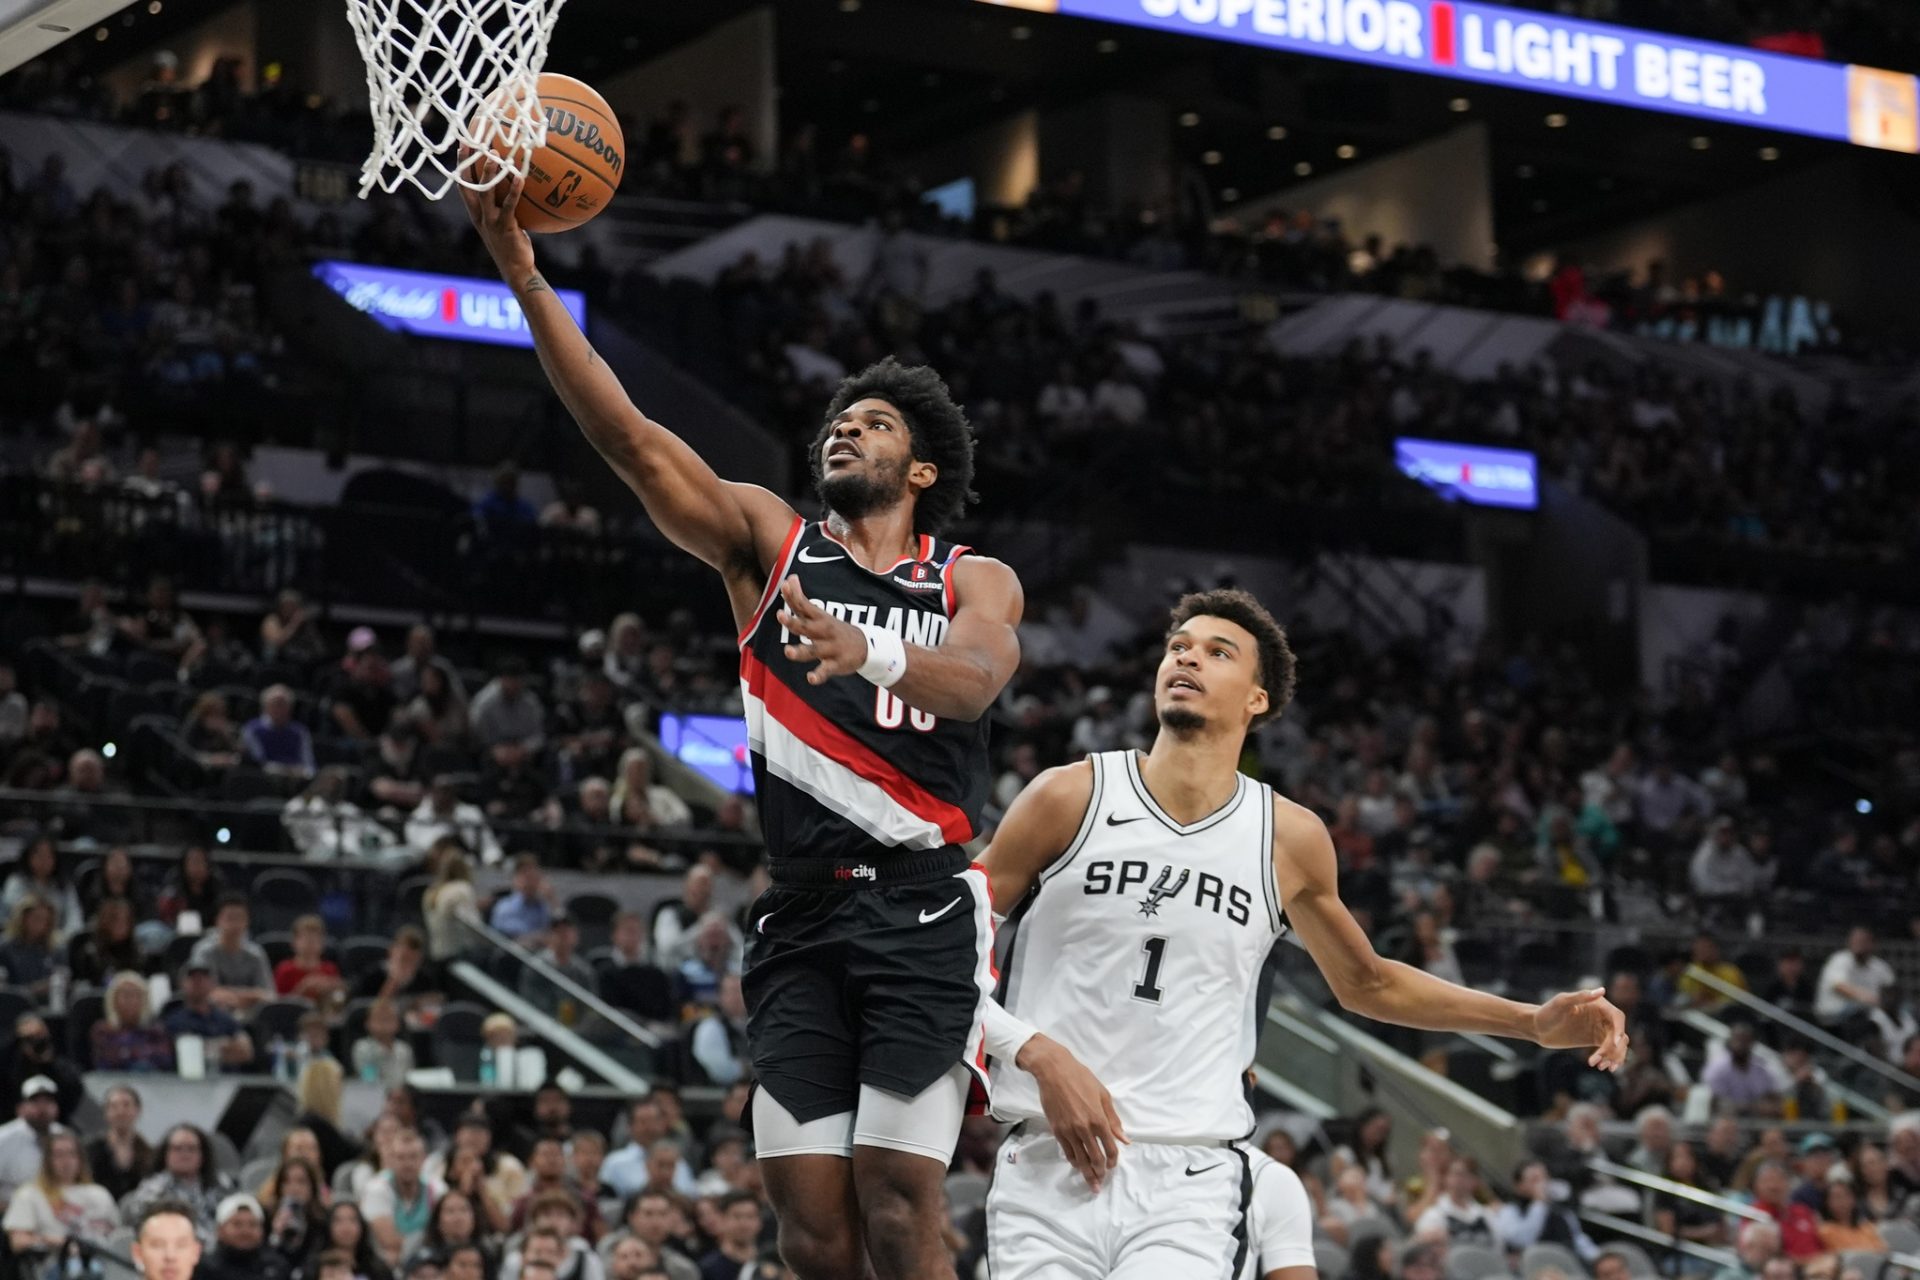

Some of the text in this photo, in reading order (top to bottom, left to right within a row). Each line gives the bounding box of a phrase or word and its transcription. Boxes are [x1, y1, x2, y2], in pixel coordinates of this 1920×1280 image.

[1463, 13, 1625, 90] LIGHT
[1634, 42, 1766, 115] BEER
[544, 106, 621, 175] Wilson
[460, 292, 529, 331] ULT
[894, 575, 943, 590] BRIGHTSIDE
[1084, 861, 1252, 927] SPURS
[1131, 935, 1169, 1005] 1
